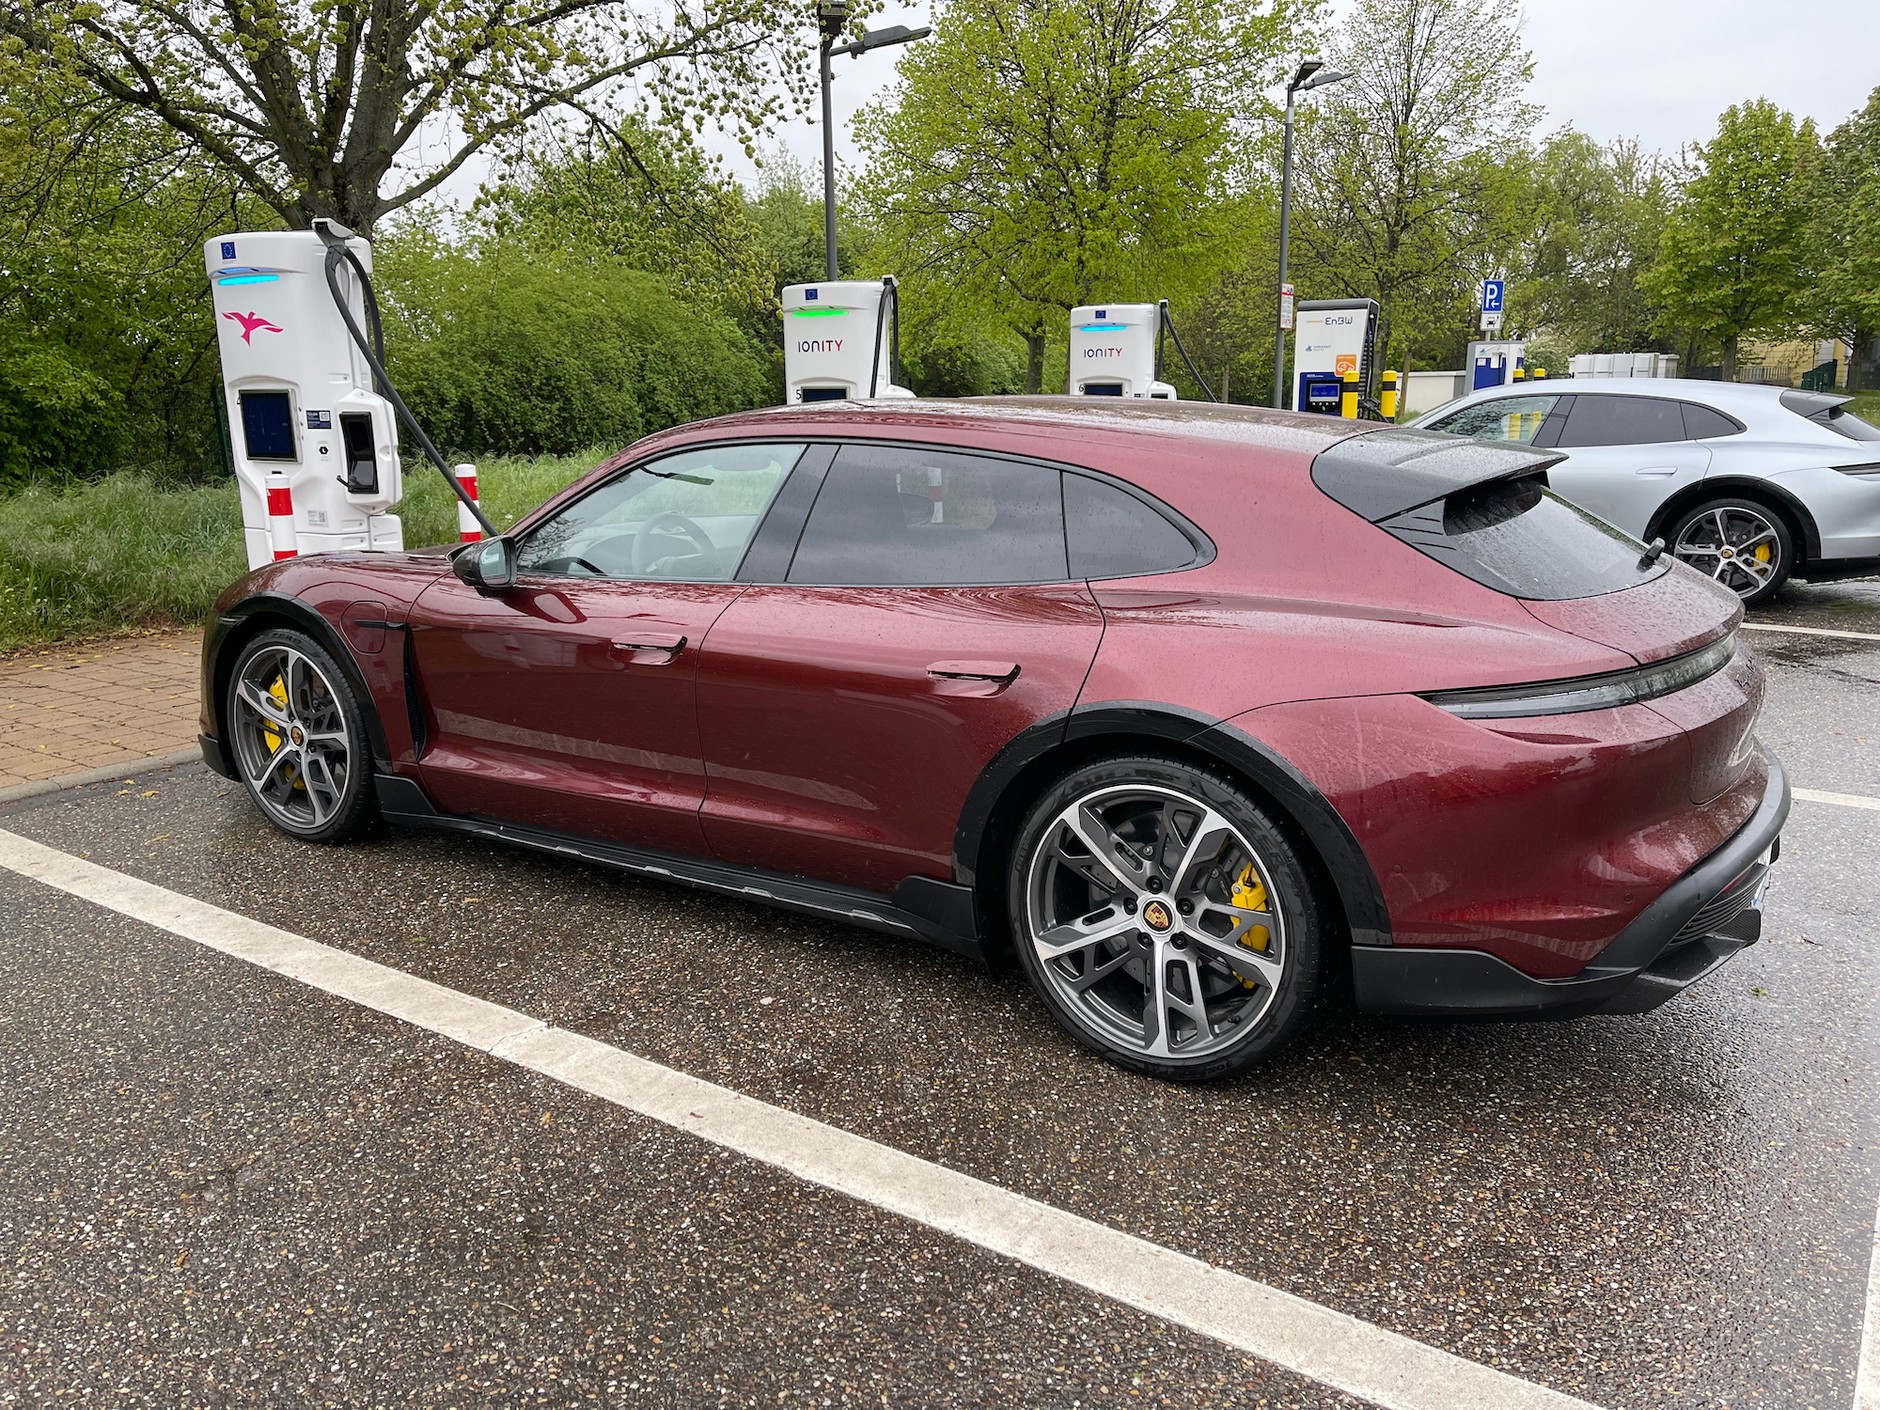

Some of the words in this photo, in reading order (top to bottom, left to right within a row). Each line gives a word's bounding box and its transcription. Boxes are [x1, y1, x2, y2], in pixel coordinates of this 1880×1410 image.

[1485, 284, 1498, 308] P
[1325, 317, 1353, 326] EnBW
[797, 340, 843, 353] IONITY
[1083, 348, 1123, 358] IONITY
[1078, 384, 1085, 393] 6
[795, 389, 802, 400] 5
